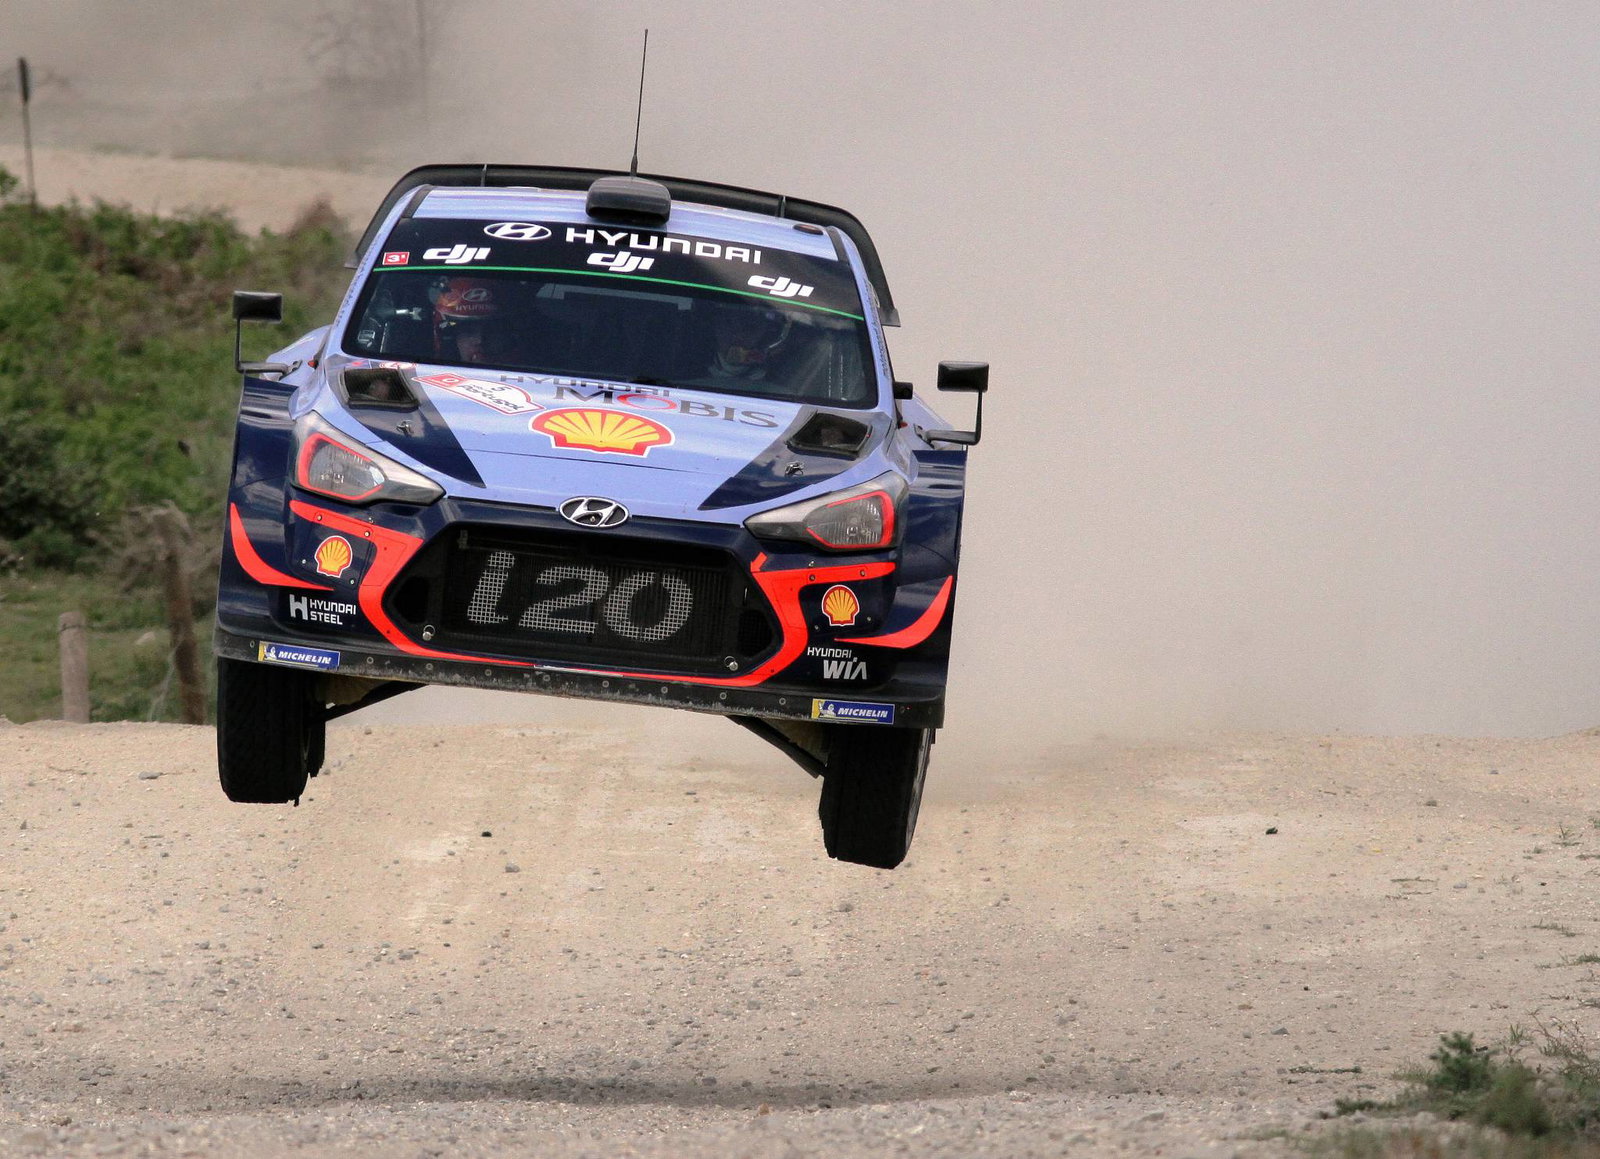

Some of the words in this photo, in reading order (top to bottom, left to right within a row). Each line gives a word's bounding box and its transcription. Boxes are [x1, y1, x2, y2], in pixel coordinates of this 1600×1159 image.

[566, 228, 761, 264] HYUNDAI
[500, 374, 670, 397] HYUNDAI
[553, 386, 778, 428] MOBIS
[309, 598, 357, 616] HYUNDAI
[310, 611, 343, 626] STEEL
[277, 650, 332, 665] MICHELIN
[807, 646, 852, 659] HYUNDAI
[837, 707, 888, 718] MICHELIN
